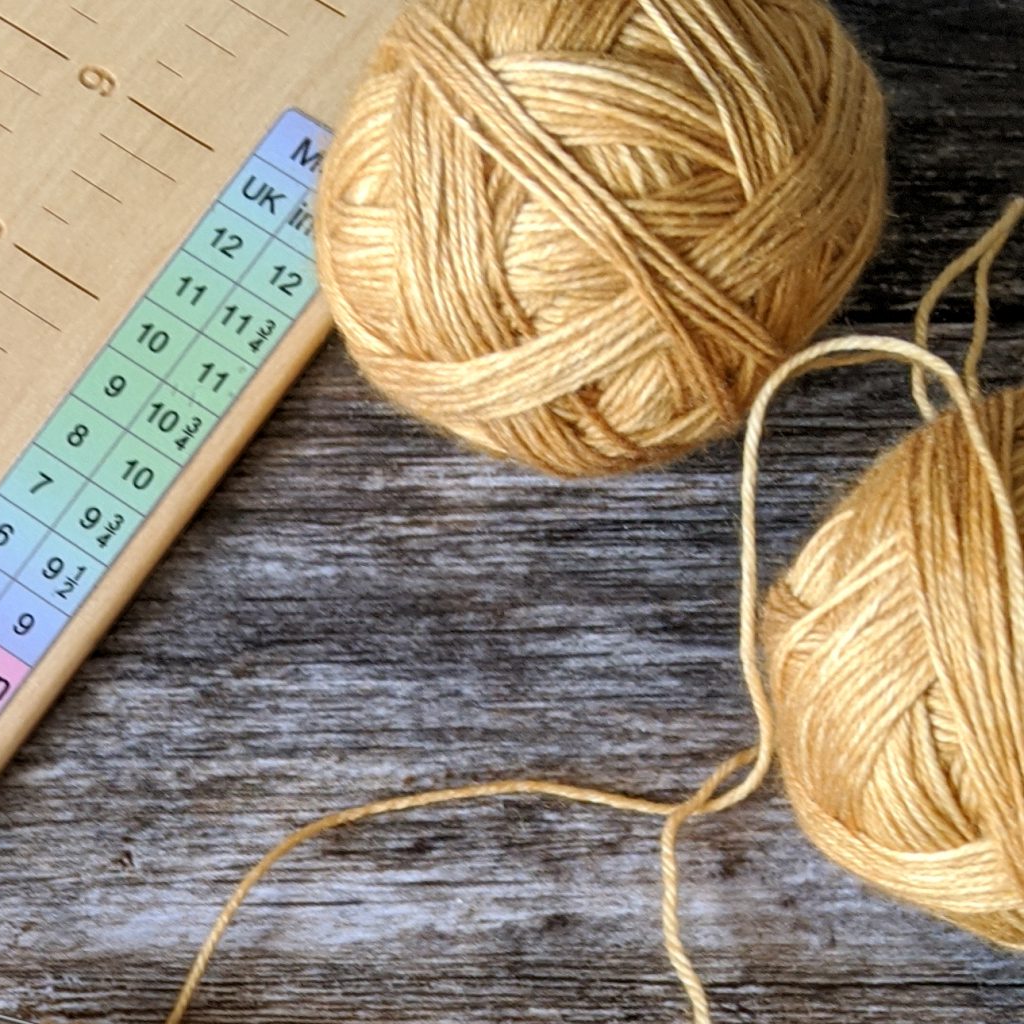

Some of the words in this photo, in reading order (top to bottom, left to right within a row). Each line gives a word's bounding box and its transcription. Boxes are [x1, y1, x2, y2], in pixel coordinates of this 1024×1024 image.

[78, 64, 118, 98] 9
[289, 136, 325, 174] M
[241, 175, 286, 214] UK
[209, 227, 244, 259] 12
[268, 265, 303, 296] 12
[175, 276, 208, 306] 11
[136, 323, 170, 354] 10
[197, 362, 229, 392] 11
[104, 375, 127, 397] 9
[66, 424, 89, 447] 8
[121, 460, 154, 490] 10
[29, 471, 54, 494] 7
[12, 613, 35, 635] 9
